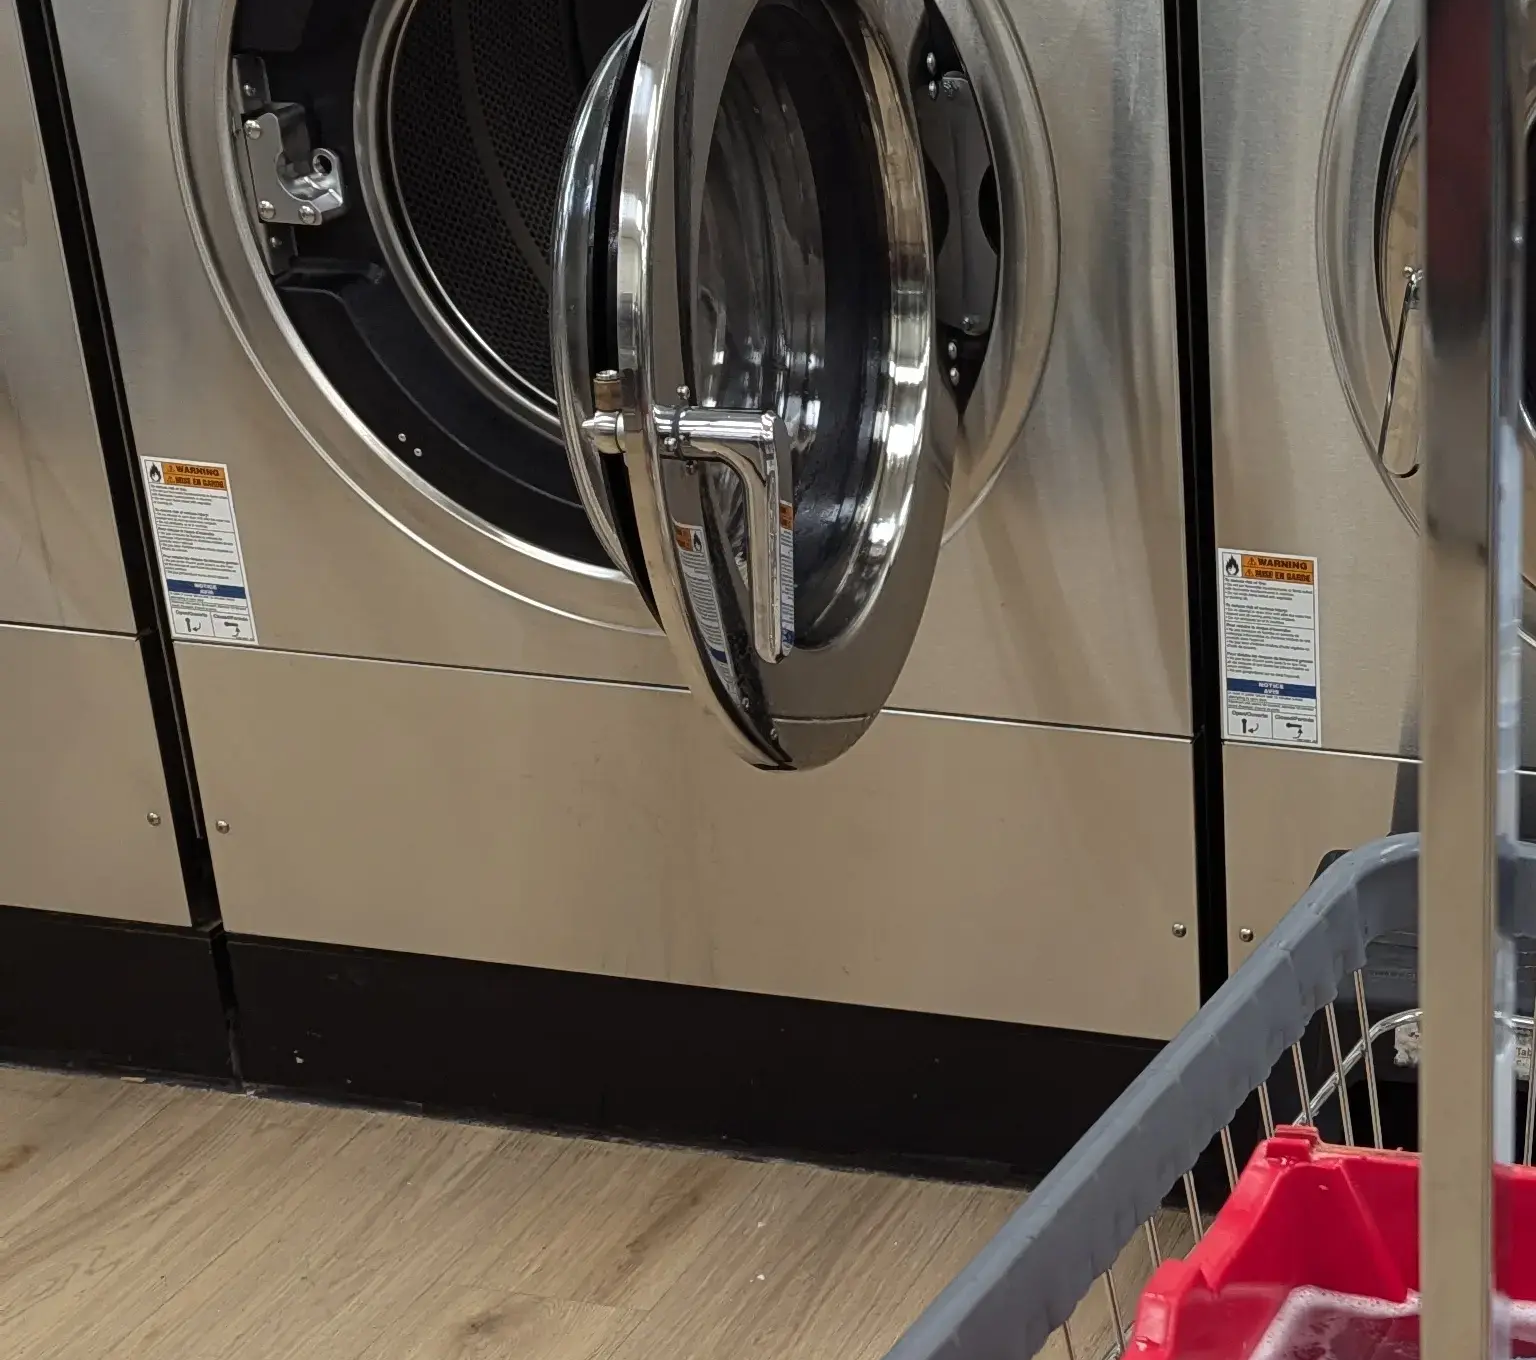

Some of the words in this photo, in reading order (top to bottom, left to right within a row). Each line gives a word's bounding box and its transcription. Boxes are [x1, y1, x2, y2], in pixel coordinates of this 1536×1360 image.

[176, 465, 219, 477] WARNING
[1257, 557, 1308, 570] WARNING
[1275, 571, 1285, 580] EN
